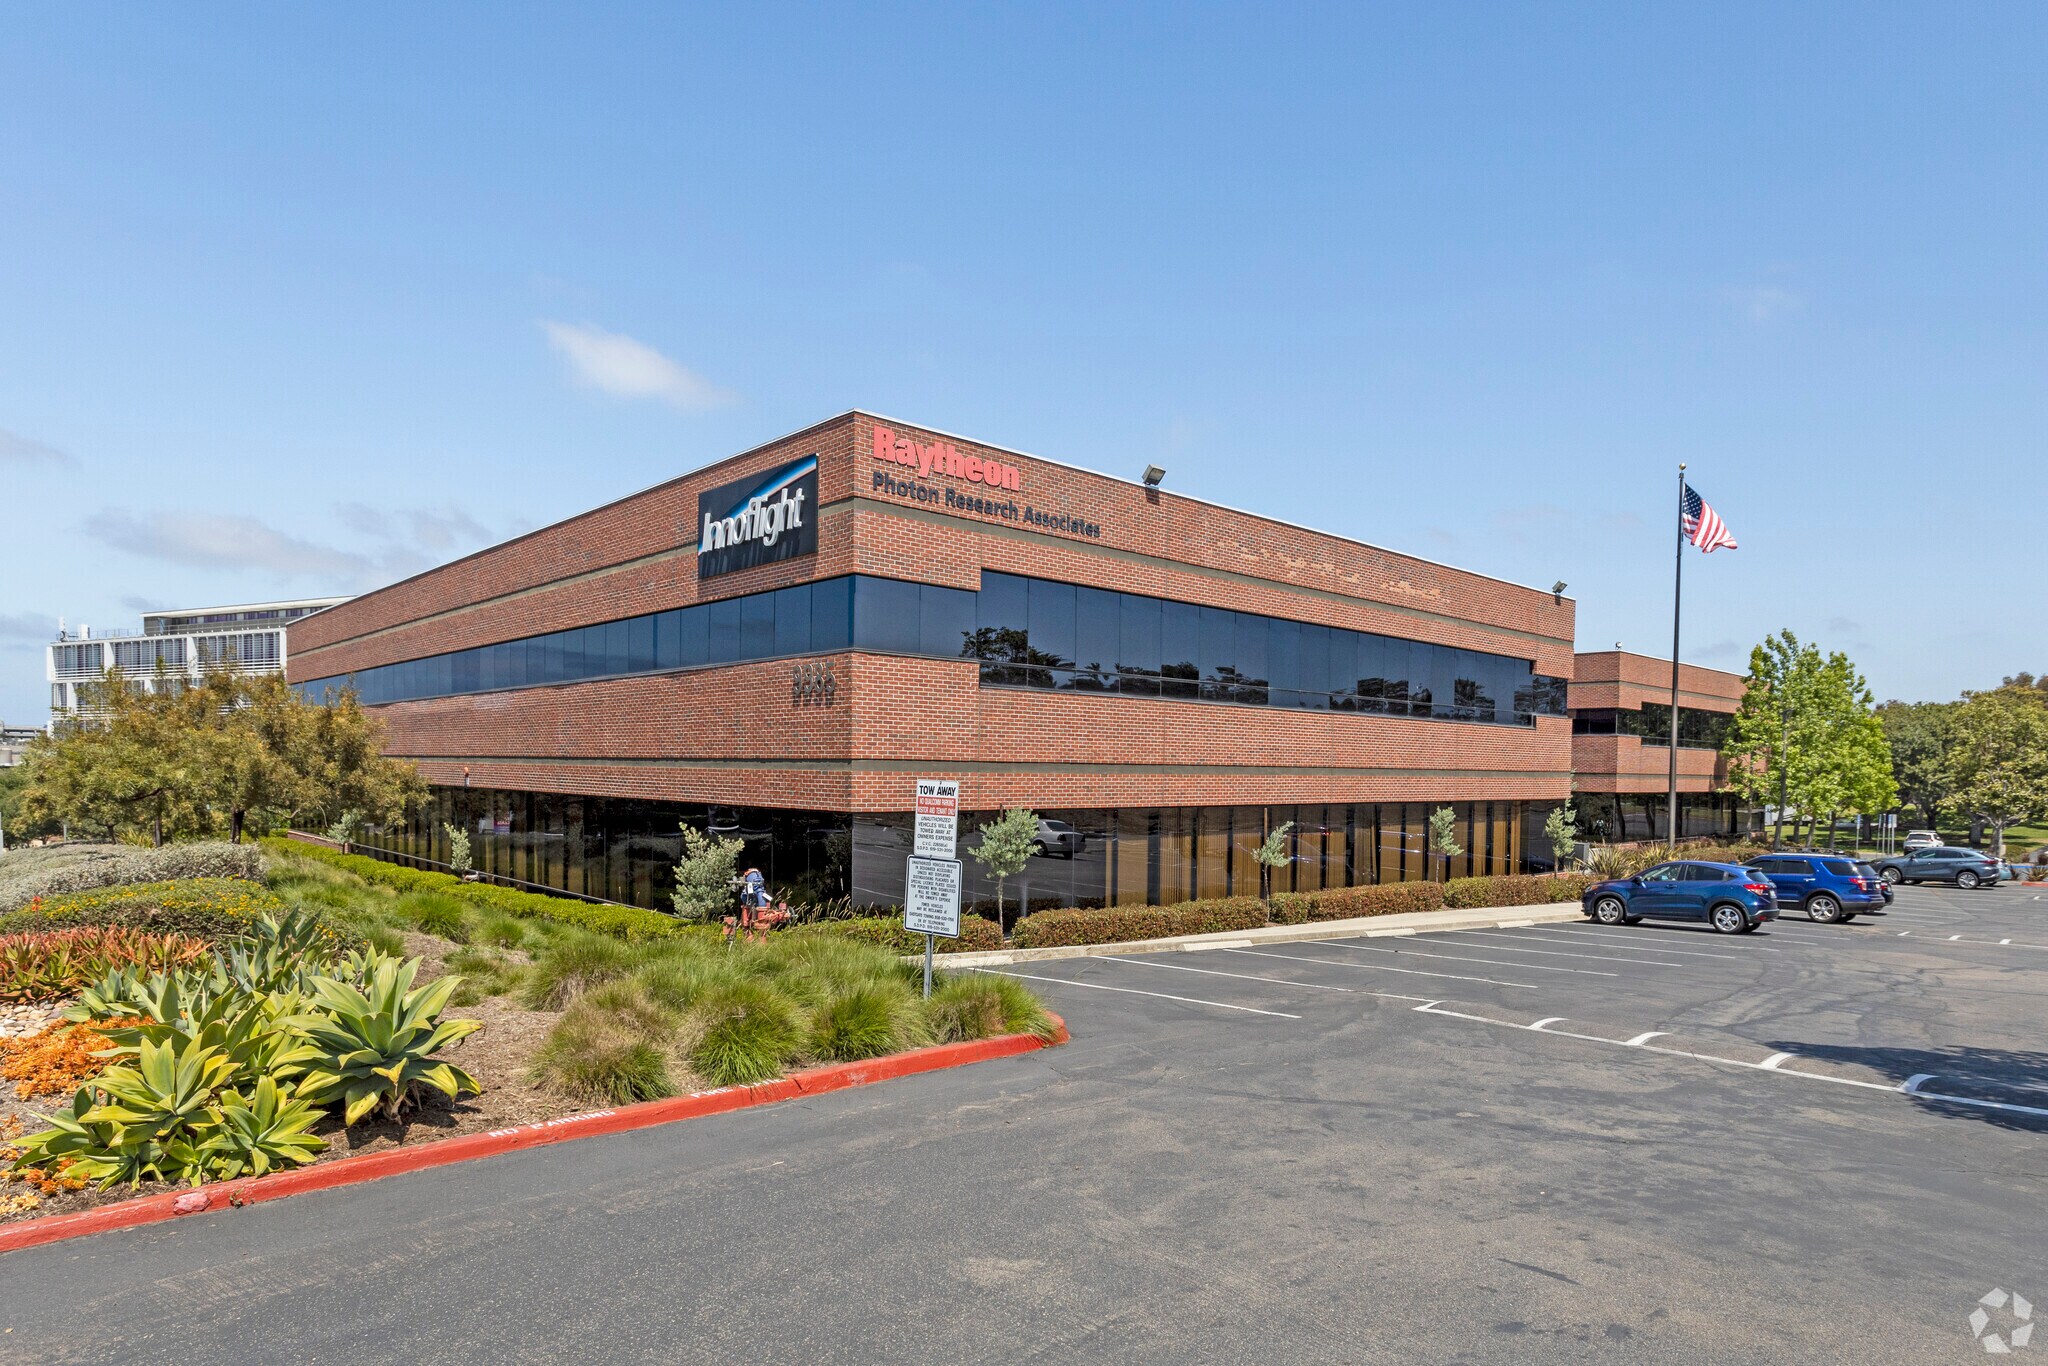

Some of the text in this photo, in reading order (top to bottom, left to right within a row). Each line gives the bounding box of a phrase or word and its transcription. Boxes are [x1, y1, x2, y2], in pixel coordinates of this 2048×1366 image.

[873, 425, 1020, 492] Raytheon
[703, 487, 804, 552] Innoflight
[873, 471, 1100, 537] Photon Research Associates
[920, 785, 956, 797] TOW AWAY
